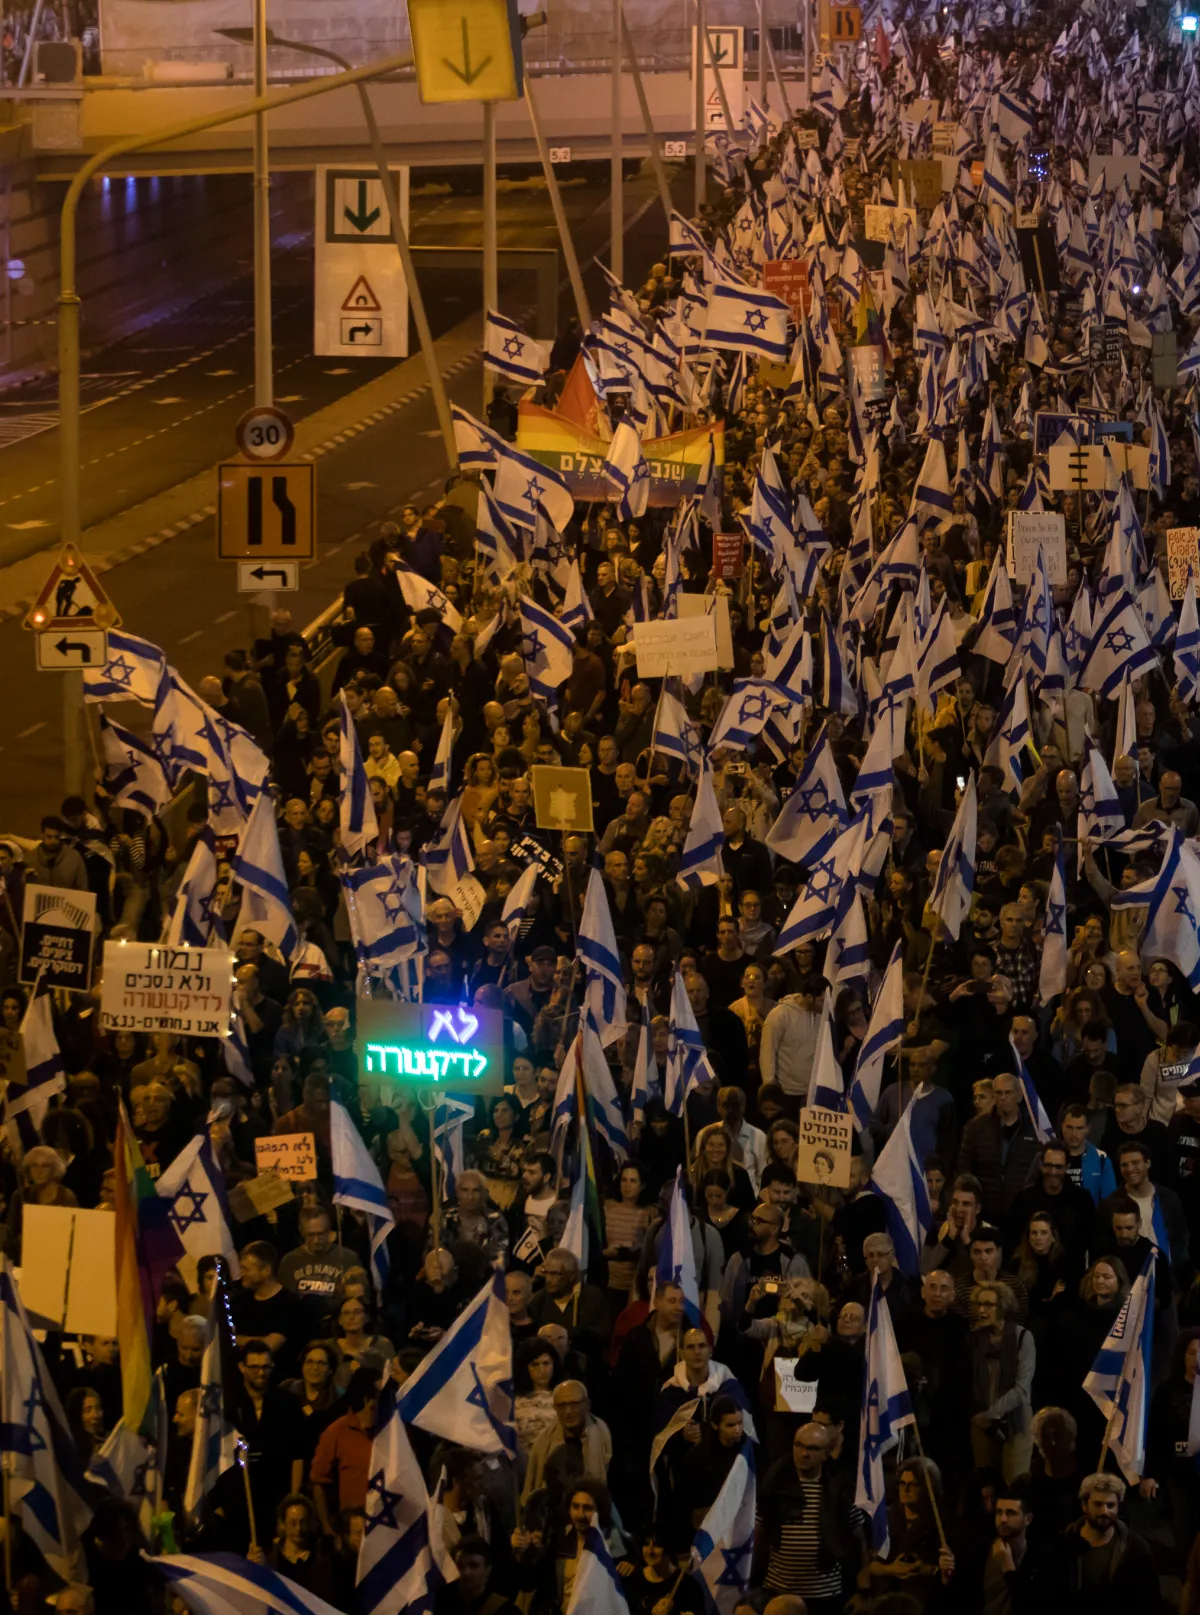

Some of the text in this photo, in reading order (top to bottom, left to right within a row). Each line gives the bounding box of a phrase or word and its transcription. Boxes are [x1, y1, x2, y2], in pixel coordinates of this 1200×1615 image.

[668, 144, 684, 155] 5.2
[249, 424, 281, 447] 30
[145, 950, 202, 971] נמות
[125, 974, 211, 991] ולא נסכים
[195, 1020, 220, 1033] אנו
[427, 1008, 479, 1045] לא
[1161, 1063, 1190, 1077] אמנים
[809, 1110, 844, 1123] יוחזר
[803, 1121, 848, 1138] המנדט
[801, 1134, 848, 1151] הבריטי
